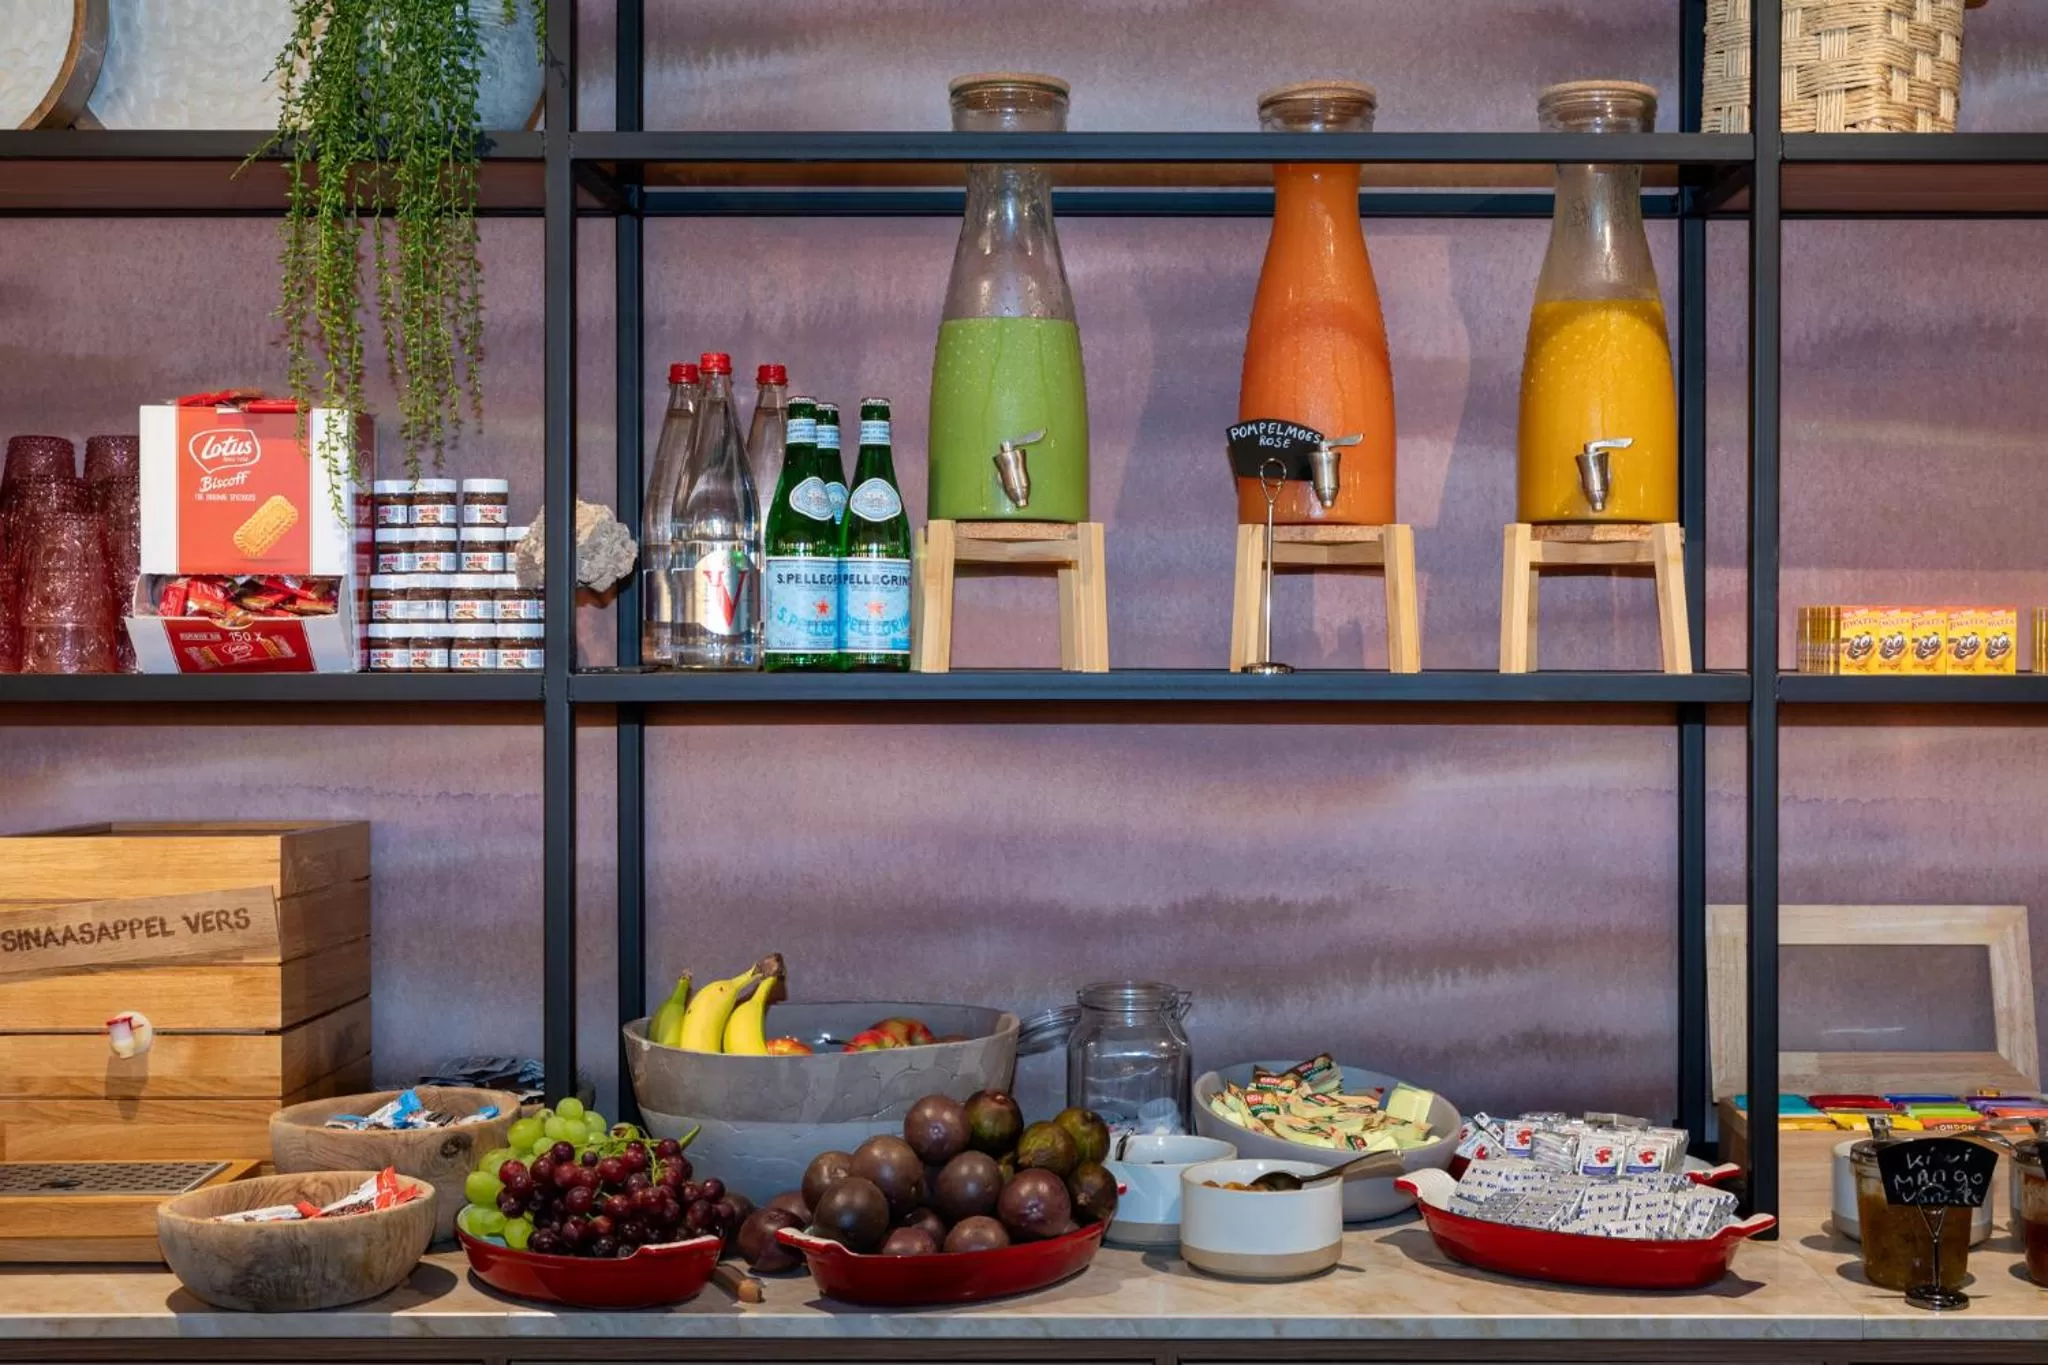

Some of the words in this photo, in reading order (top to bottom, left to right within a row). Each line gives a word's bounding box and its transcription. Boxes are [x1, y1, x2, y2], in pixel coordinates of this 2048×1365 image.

[1231, 422, 1322, 444] POMPELMOES
[1259, 436, 1292, 449] ROSE
[201, 435, 252, 459] Lotus
[199, 471, 252, 492] Biscoff
[228, 631, 251, 642] 150
[1, 916, 175, 951] SINAASAPPEL
[182, 908, 250, 934] VERS
